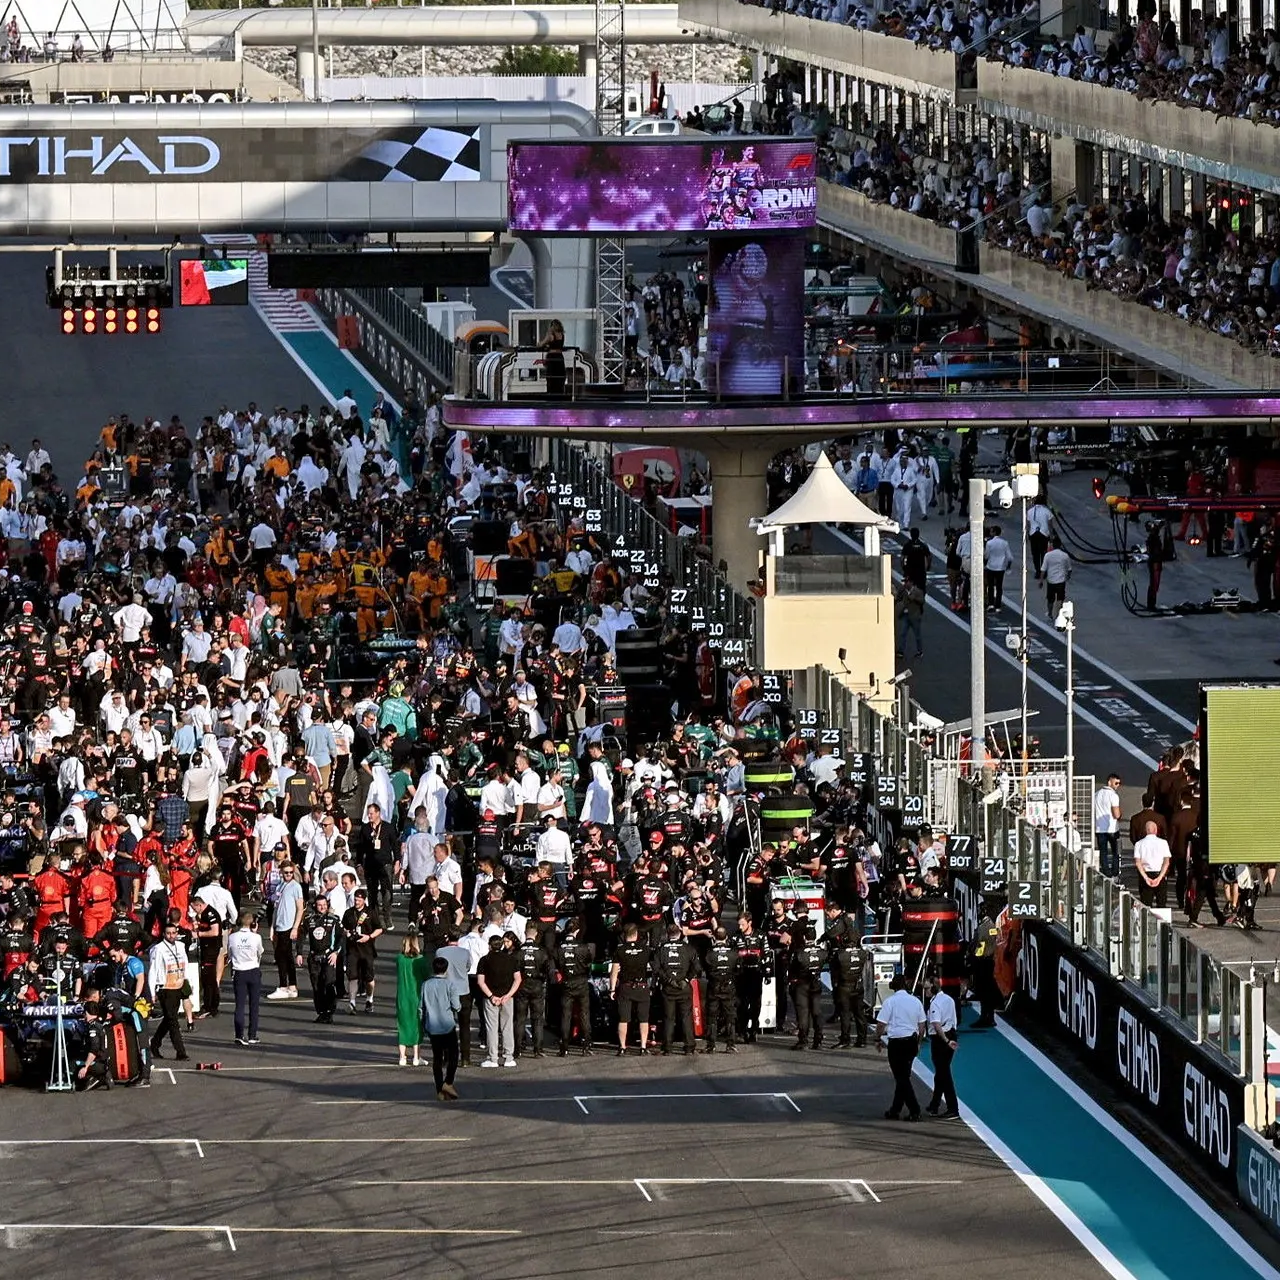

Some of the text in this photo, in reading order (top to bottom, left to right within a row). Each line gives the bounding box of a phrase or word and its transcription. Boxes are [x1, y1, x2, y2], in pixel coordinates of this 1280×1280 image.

[550, 472, 557, 484] 1
[546, 486, 556, 494] VE
[558, 484, 572, 495] 16
[573, 497, 587, 508] 81
[586, 509, 601, 521] 63
[586, 523, 601, 532] RUS
[615, 535, 625, 547] 4
[630, 550, 646, 562] 22
[643, 563, 659, 576] 14
[643, 578, 660, 587] ALO
[671, 589, 688, 602] 27
[670, 605, 688, 614] HUL
[692, 607, 705, 619] 11
[709, 623, 724, 636] 10
[723, 640, 744, 652] 44
[762, 675, 781, 689] 31
[799, 710, 817, 725] 18
[800, 728, 817, 738] STR
[821, 729, 840, 744] 23
[853, 753, 864, 768] 3
[850, 772, 867, 782] RIC
[877, 777, 896, 792] 55
[878, 796, 895, 806] SAI
[904, 796, 922, 811] 20
[903, 815, 923, 826] MAG
[949, 835, 971, 851] 77
[949, 856, 972, 867] BOT
[984, 859, 1005, 876] 24
[1018, 883, 1031, 899] 2
[1012, 904, 1037, 916] SAR
[1057, 955, 1097, 1050] ETIHAD
[39, 1003, 85, 1016] krake
[1117, 1006, 1161, 1106] ETIHAD
[1182, 1061, 1231, 1169] ETIHAD
